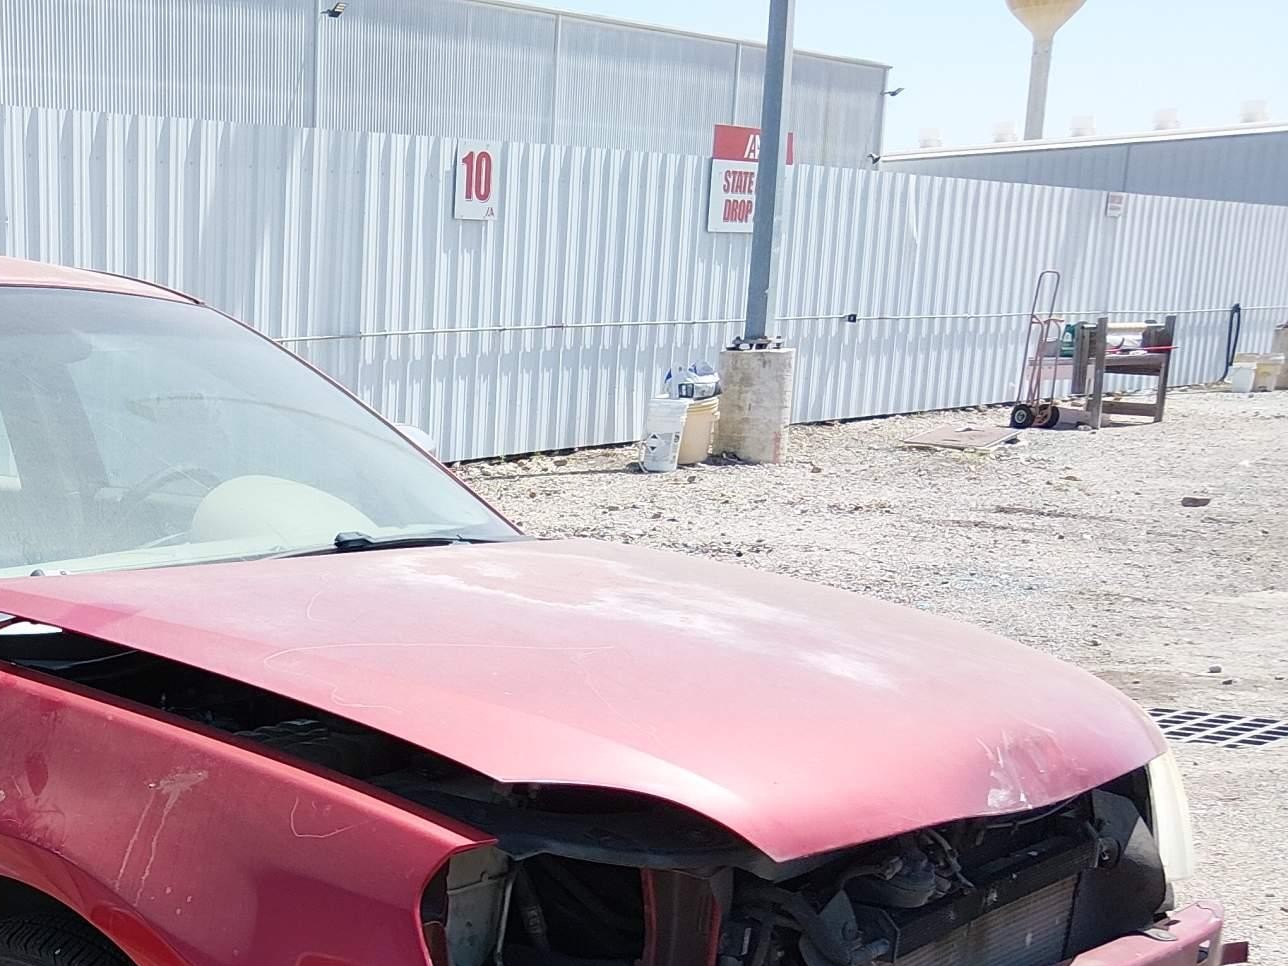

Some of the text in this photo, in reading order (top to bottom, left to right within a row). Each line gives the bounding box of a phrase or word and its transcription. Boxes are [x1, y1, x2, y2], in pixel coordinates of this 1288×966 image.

[462, 151, 492, 202] 10
[723, 170, 755, 194] STATE
[723, 199, 753, 223] DROP
